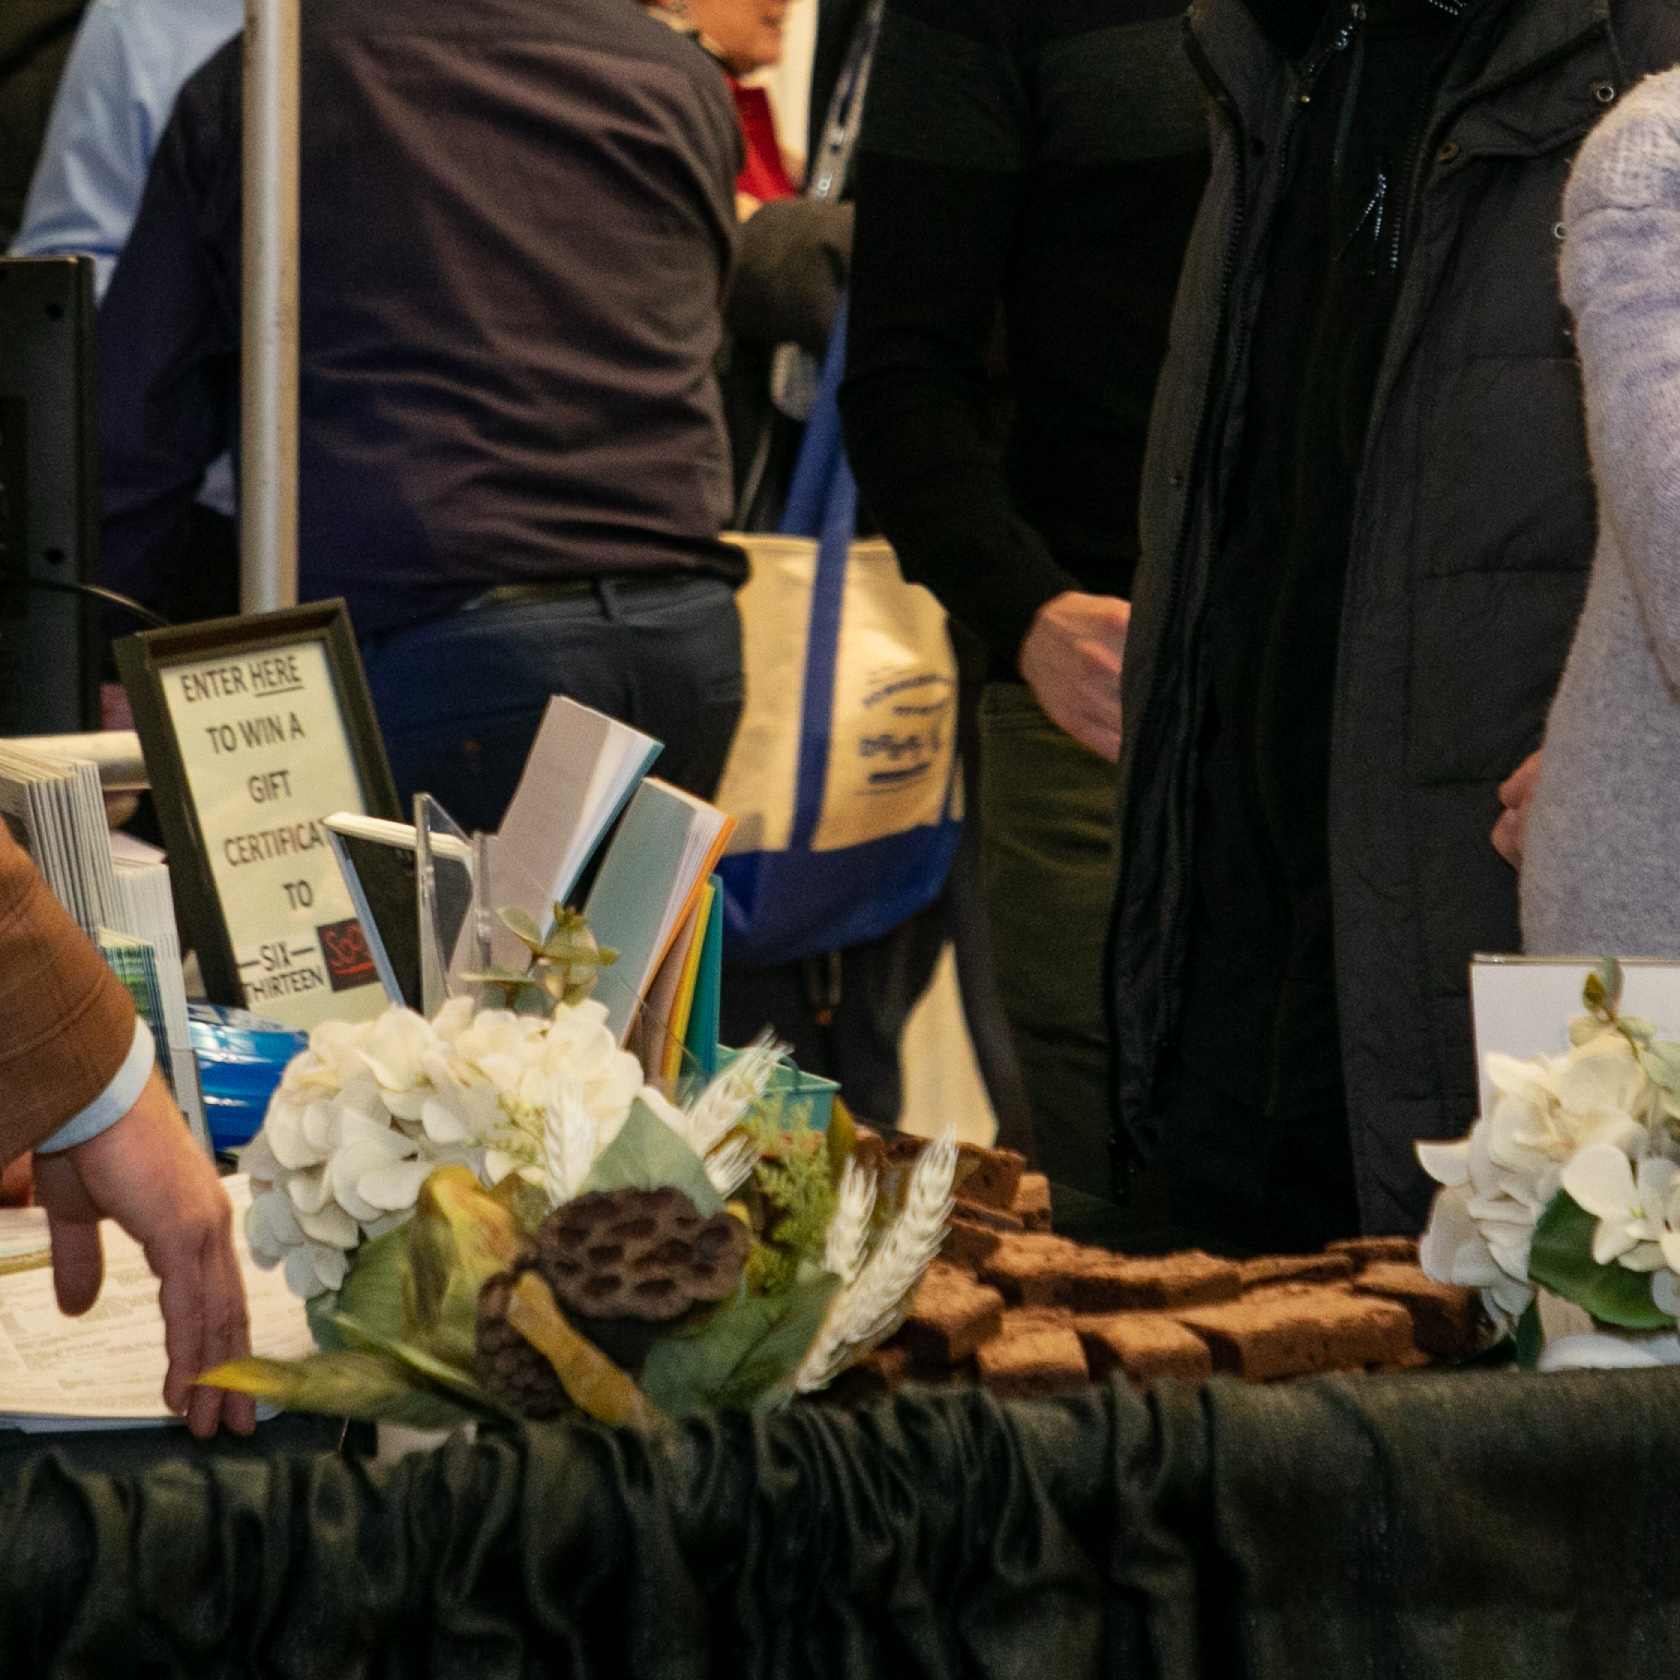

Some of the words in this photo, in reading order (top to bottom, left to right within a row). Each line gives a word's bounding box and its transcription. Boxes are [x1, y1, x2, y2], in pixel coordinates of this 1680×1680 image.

[179, 667, 248, 703] ENTER
[250, 653, 301, 690] HERE
[205, 723, 237, 755] TO
[239, 715, 284, 749] WIN
[287, 711, 306, 742] A
[247, 769, 293, 805] GIFT
[224, 819, 327, 867] CERTIFICA
[283, 879, 314, 910] TO
[261, 941, 291, 972] SIX
[242, 964, 324, 1004] THIRTEEN
